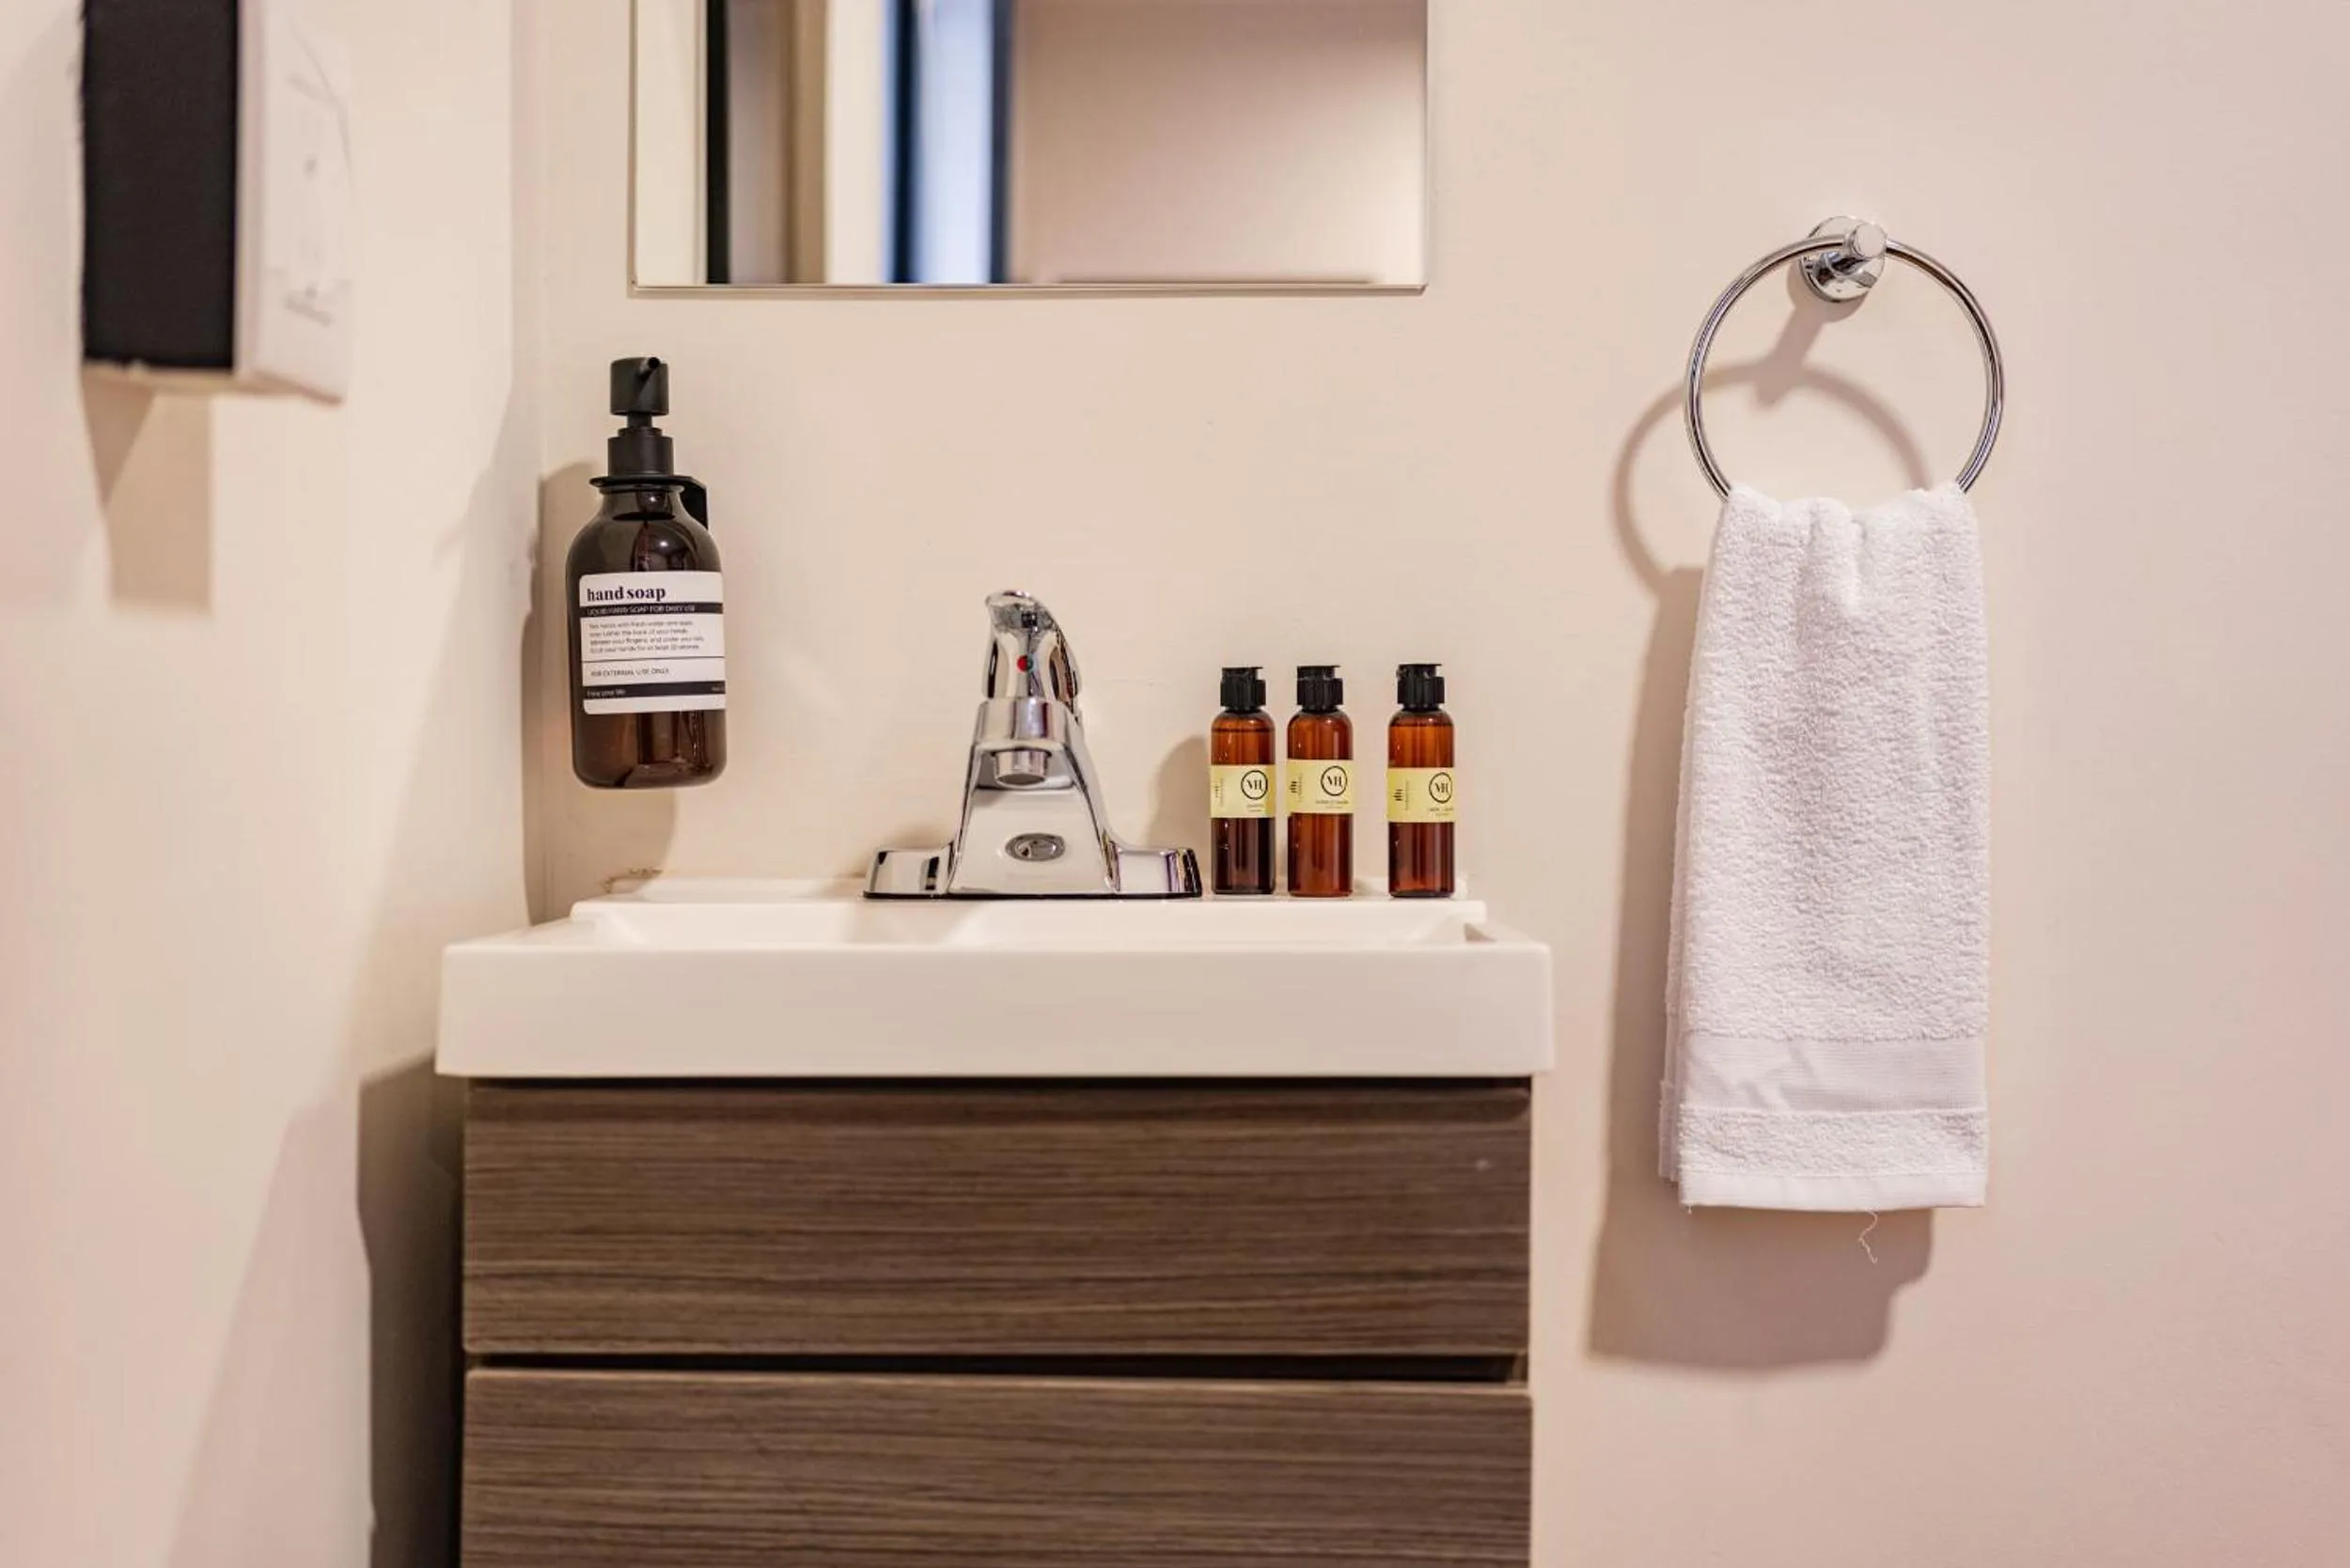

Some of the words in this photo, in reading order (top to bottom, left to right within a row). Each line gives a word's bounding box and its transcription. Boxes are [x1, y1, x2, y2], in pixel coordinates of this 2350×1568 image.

[587, 586, 624, 602] hand
[627, 588, 666, 603] soap
[603, 668, 634, 677] EXTERNAL
